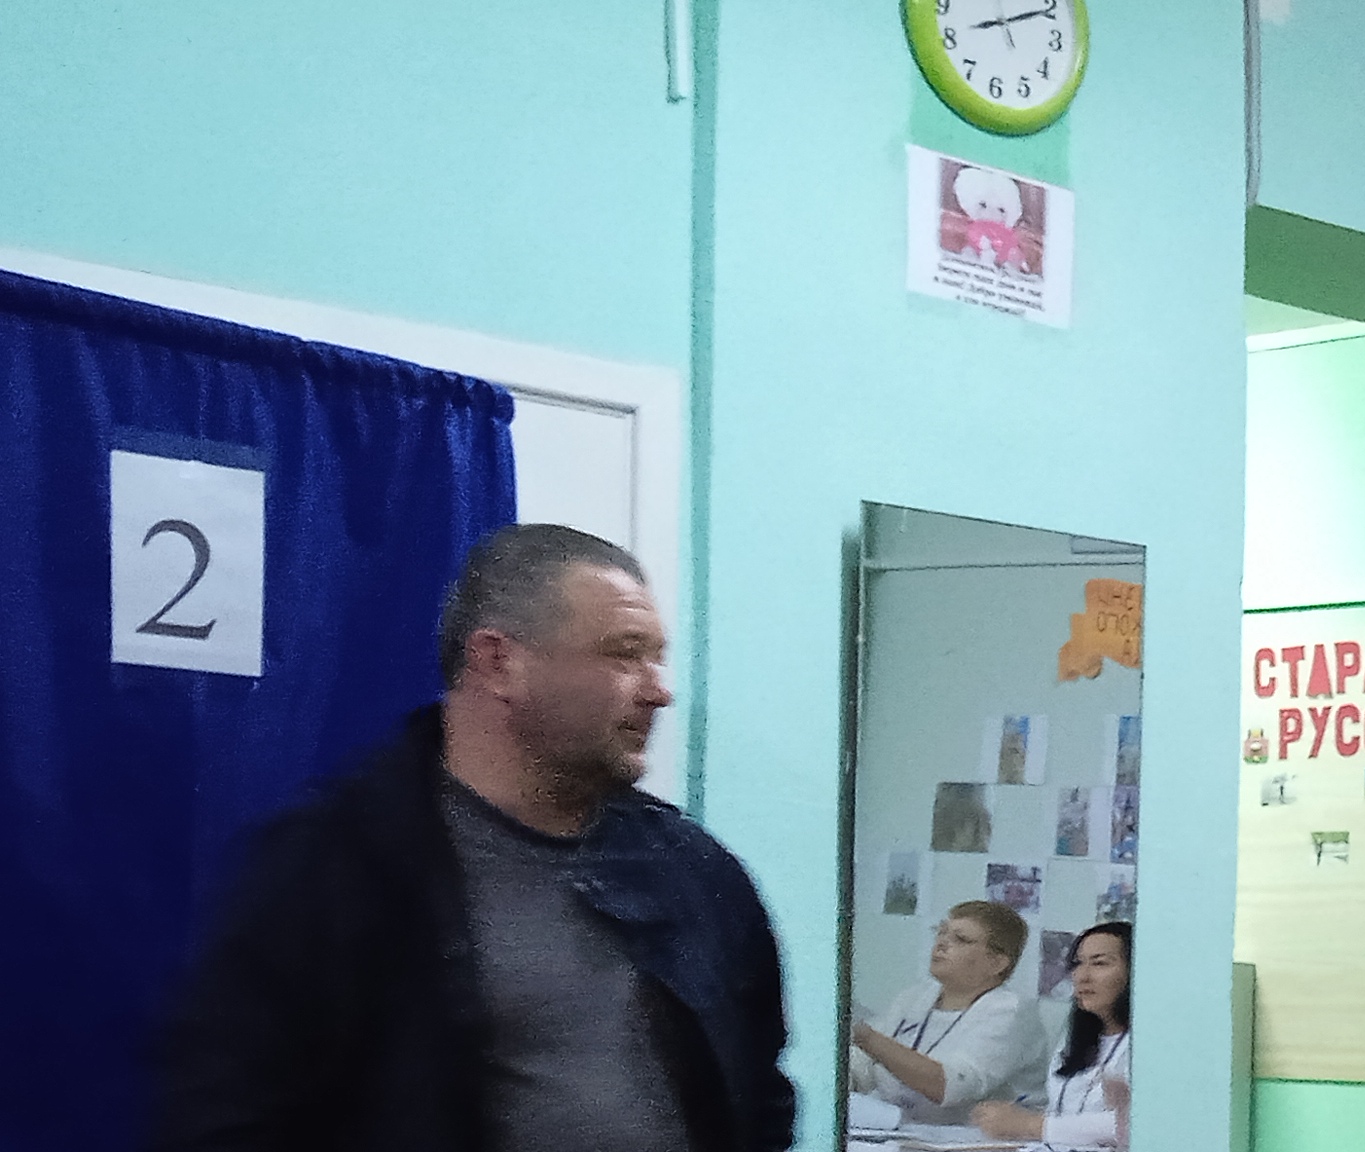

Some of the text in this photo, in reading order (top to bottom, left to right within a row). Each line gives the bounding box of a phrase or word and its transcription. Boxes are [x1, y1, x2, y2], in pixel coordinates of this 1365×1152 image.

[943, 27, 957, 50] 8
[1048, 29, 1063, 52] 3
[963, 58, 977, 81] 7
[1036, 56, 1050, 80] 4
[989, 76, 1003, 99] 6
[1017, 75, 1031, 98] 5
[135, 518, 217, 640] 2
